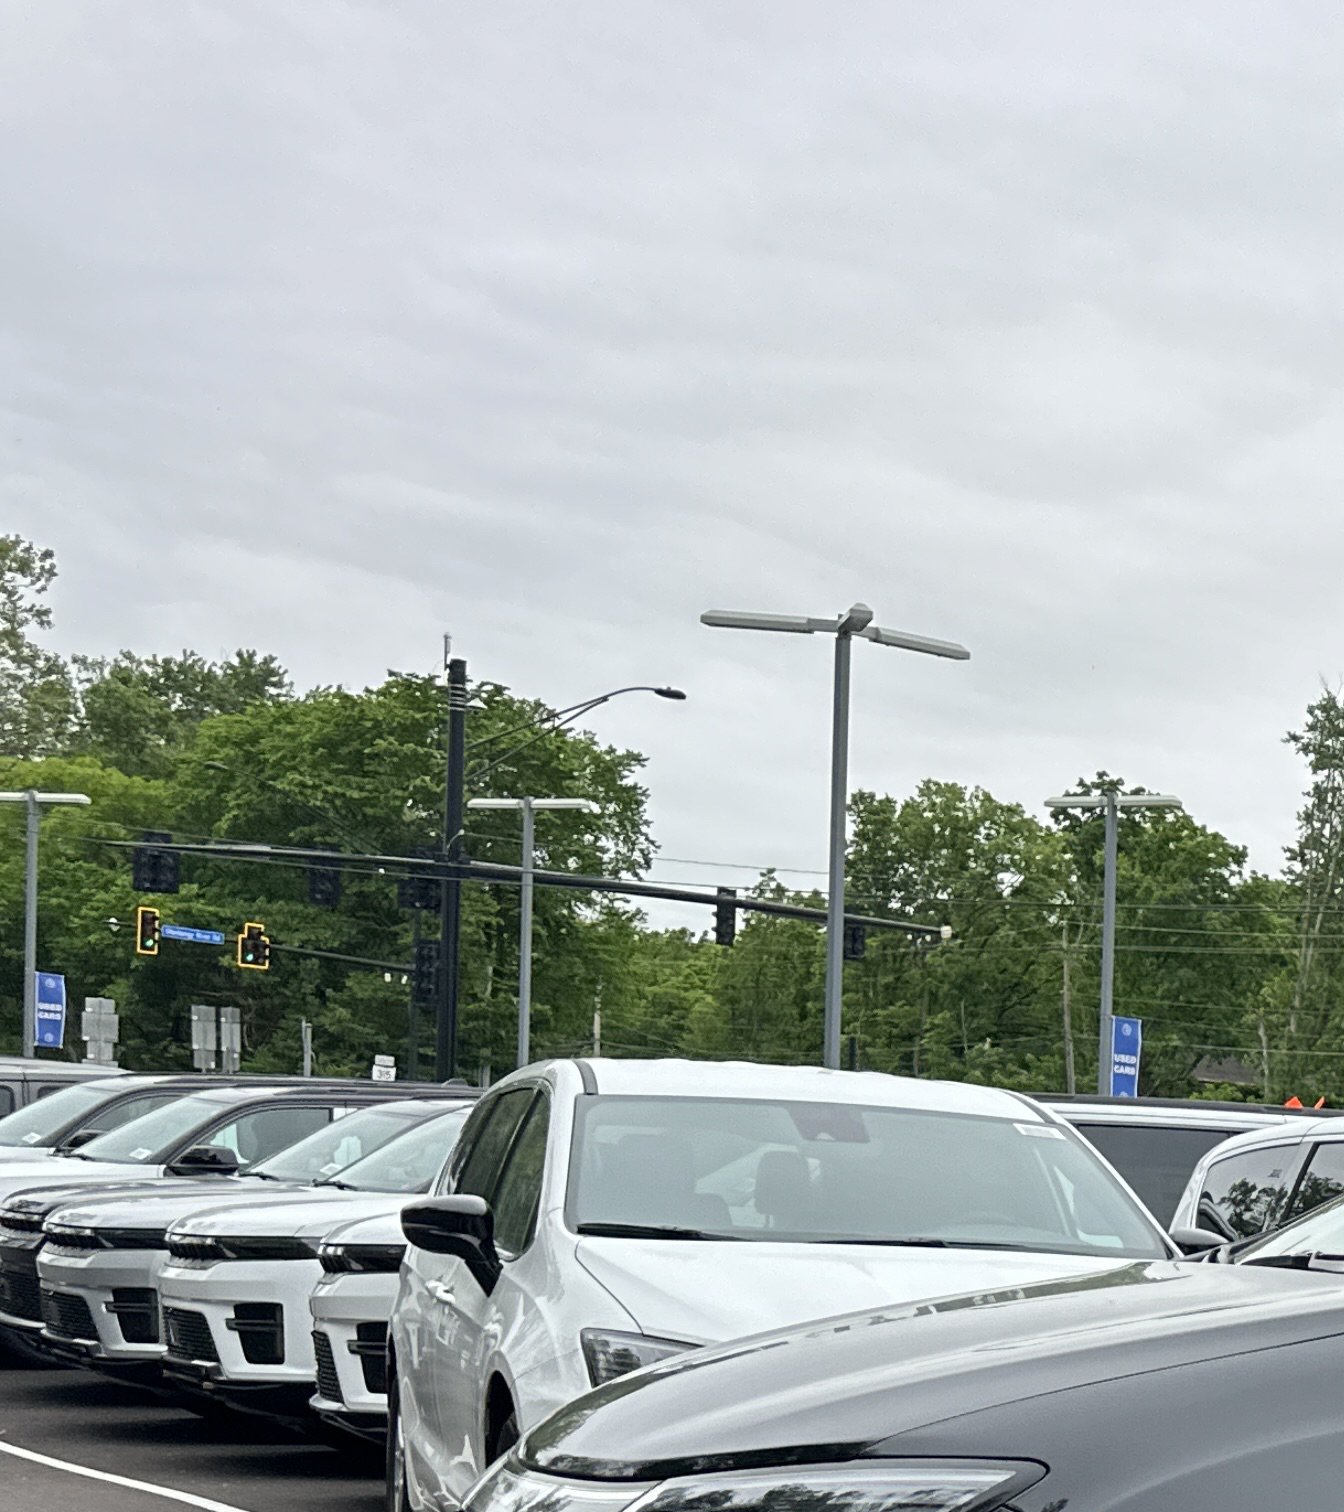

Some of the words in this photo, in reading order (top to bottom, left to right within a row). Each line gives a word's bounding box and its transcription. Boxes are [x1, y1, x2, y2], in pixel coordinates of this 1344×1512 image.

[38, 1002, 62, 1011] USED
[38, 1011, 62, 1020] CARS
[1114, 1054, 1136, 1064] USED
[376, 1069, 393, 1079] 315
[1114, 1064, 1136, 1075] CARS
